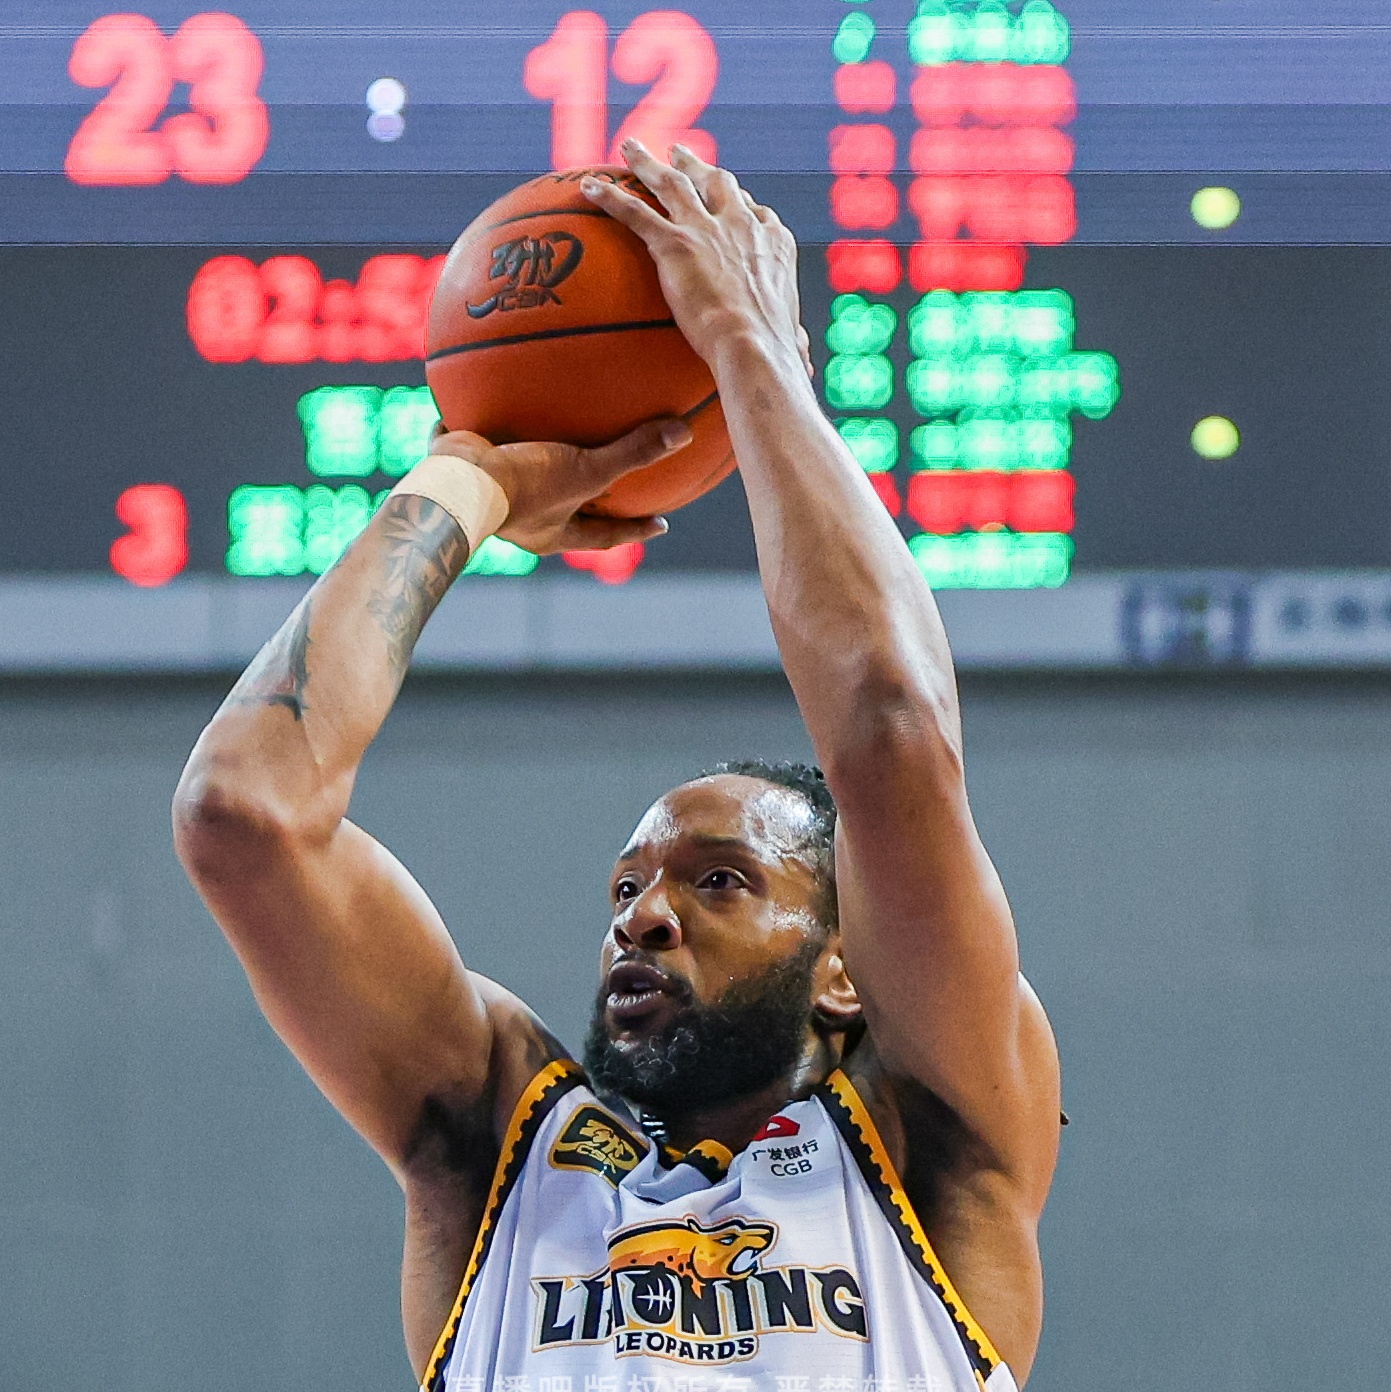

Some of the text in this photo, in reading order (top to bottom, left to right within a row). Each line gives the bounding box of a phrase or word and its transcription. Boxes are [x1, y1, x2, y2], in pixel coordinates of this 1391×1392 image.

[64, 12, 270, 187] 23
[524, 9, 718, 170] 12
[110, 483, 189, 588] 3
[751, 1138, 820, 1162] 广发银行
[770, 1158, 813, 1177] CGB
[615, 1331, 757, 1361] LEOPARDS
